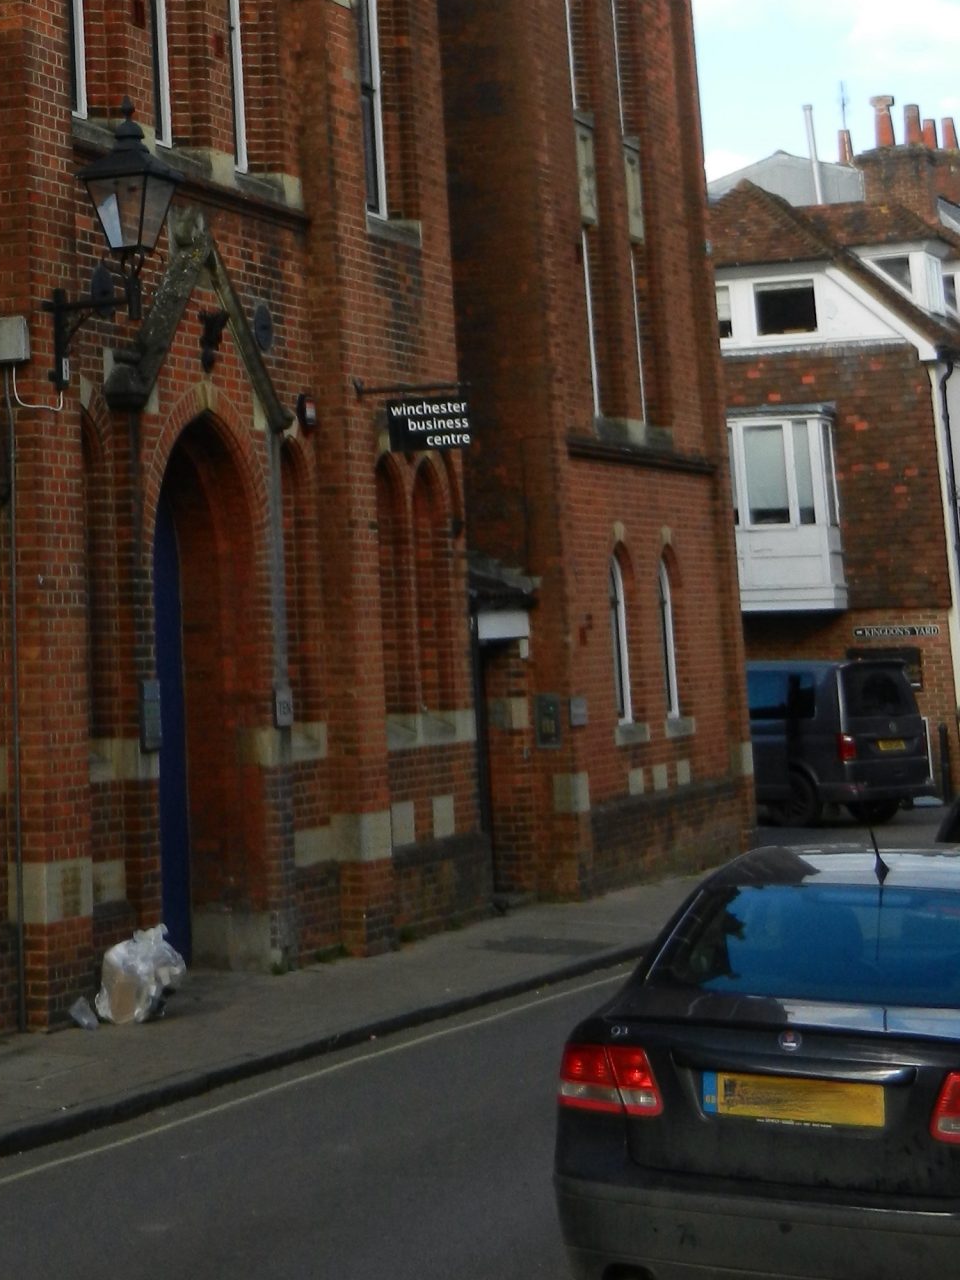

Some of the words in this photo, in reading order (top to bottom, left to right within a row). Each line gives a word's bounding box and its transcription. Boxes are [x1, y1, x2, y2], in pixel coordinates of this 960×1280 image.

[390, 401, 467, 416] winchester
[407, 417, 469, 431] business
[426, 433, 471, 446] centre
[914, 626, 938, 637] YARD
